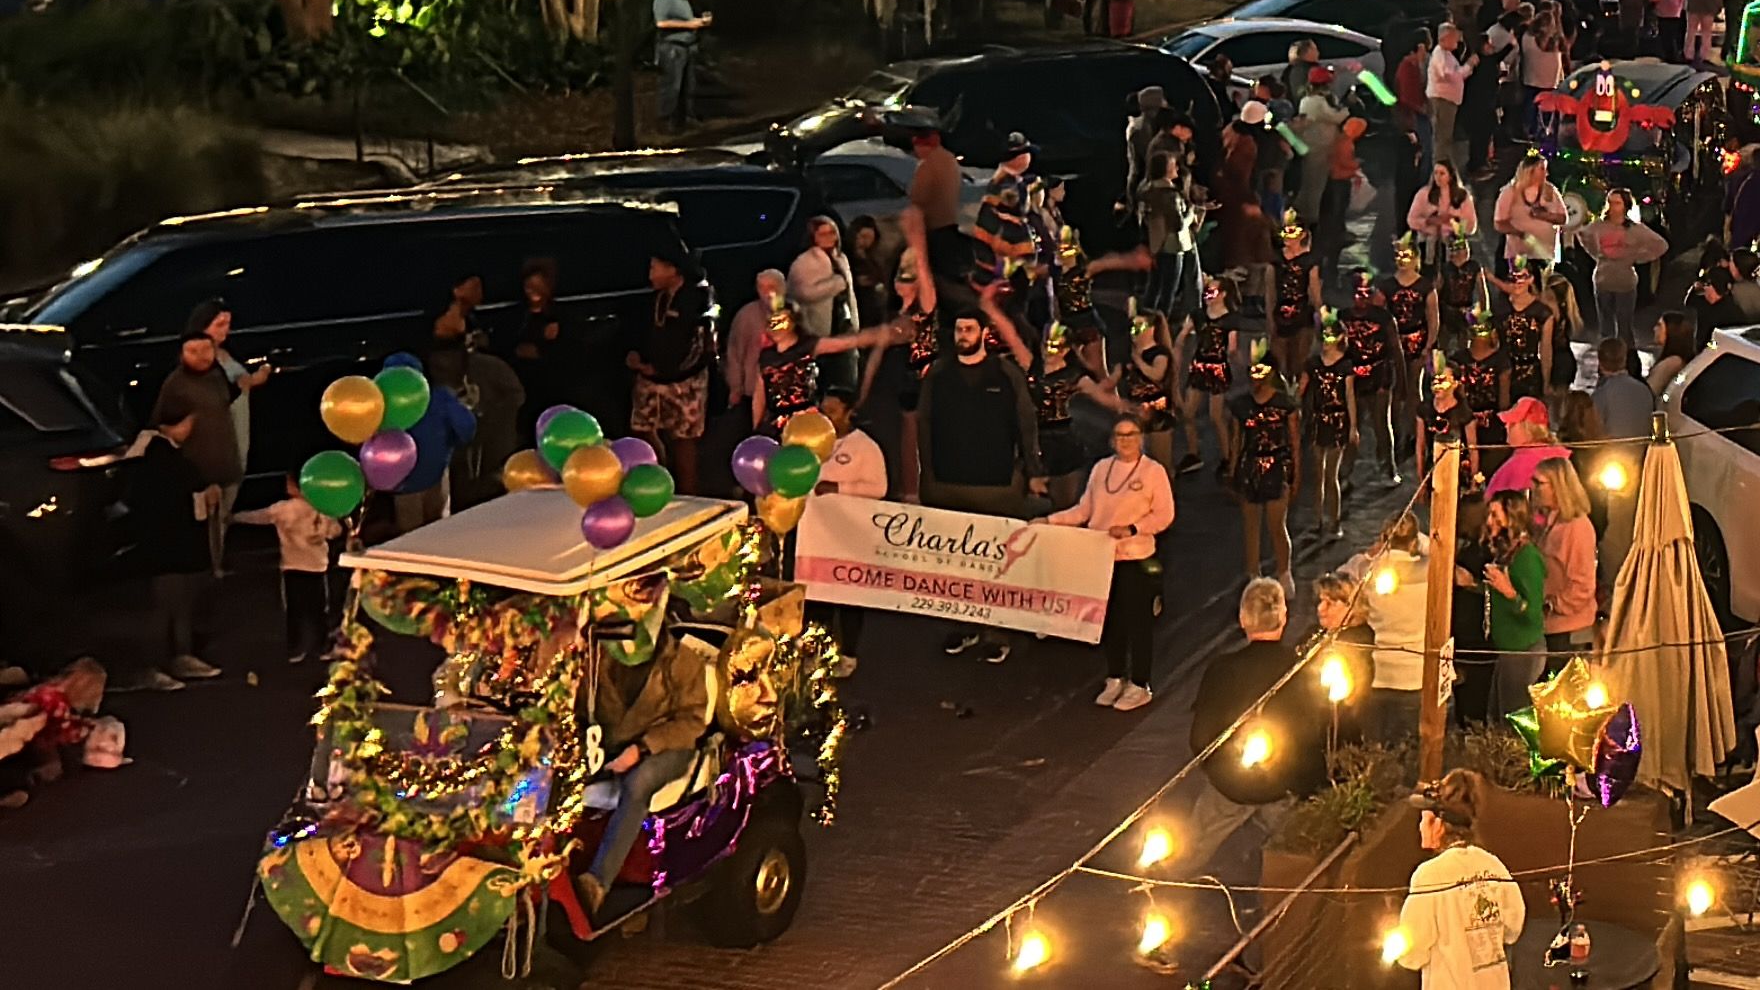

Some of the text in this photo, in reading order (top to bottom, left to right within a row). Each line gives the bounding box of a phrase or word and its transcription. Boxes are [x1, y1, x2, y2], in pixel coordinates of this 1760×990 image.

[872, 512, 1007, 560] Charla's
[833, 565, 1071, 615] COME DANCE WITH US!
[911, 596, 992, 619] 229.393.7243
